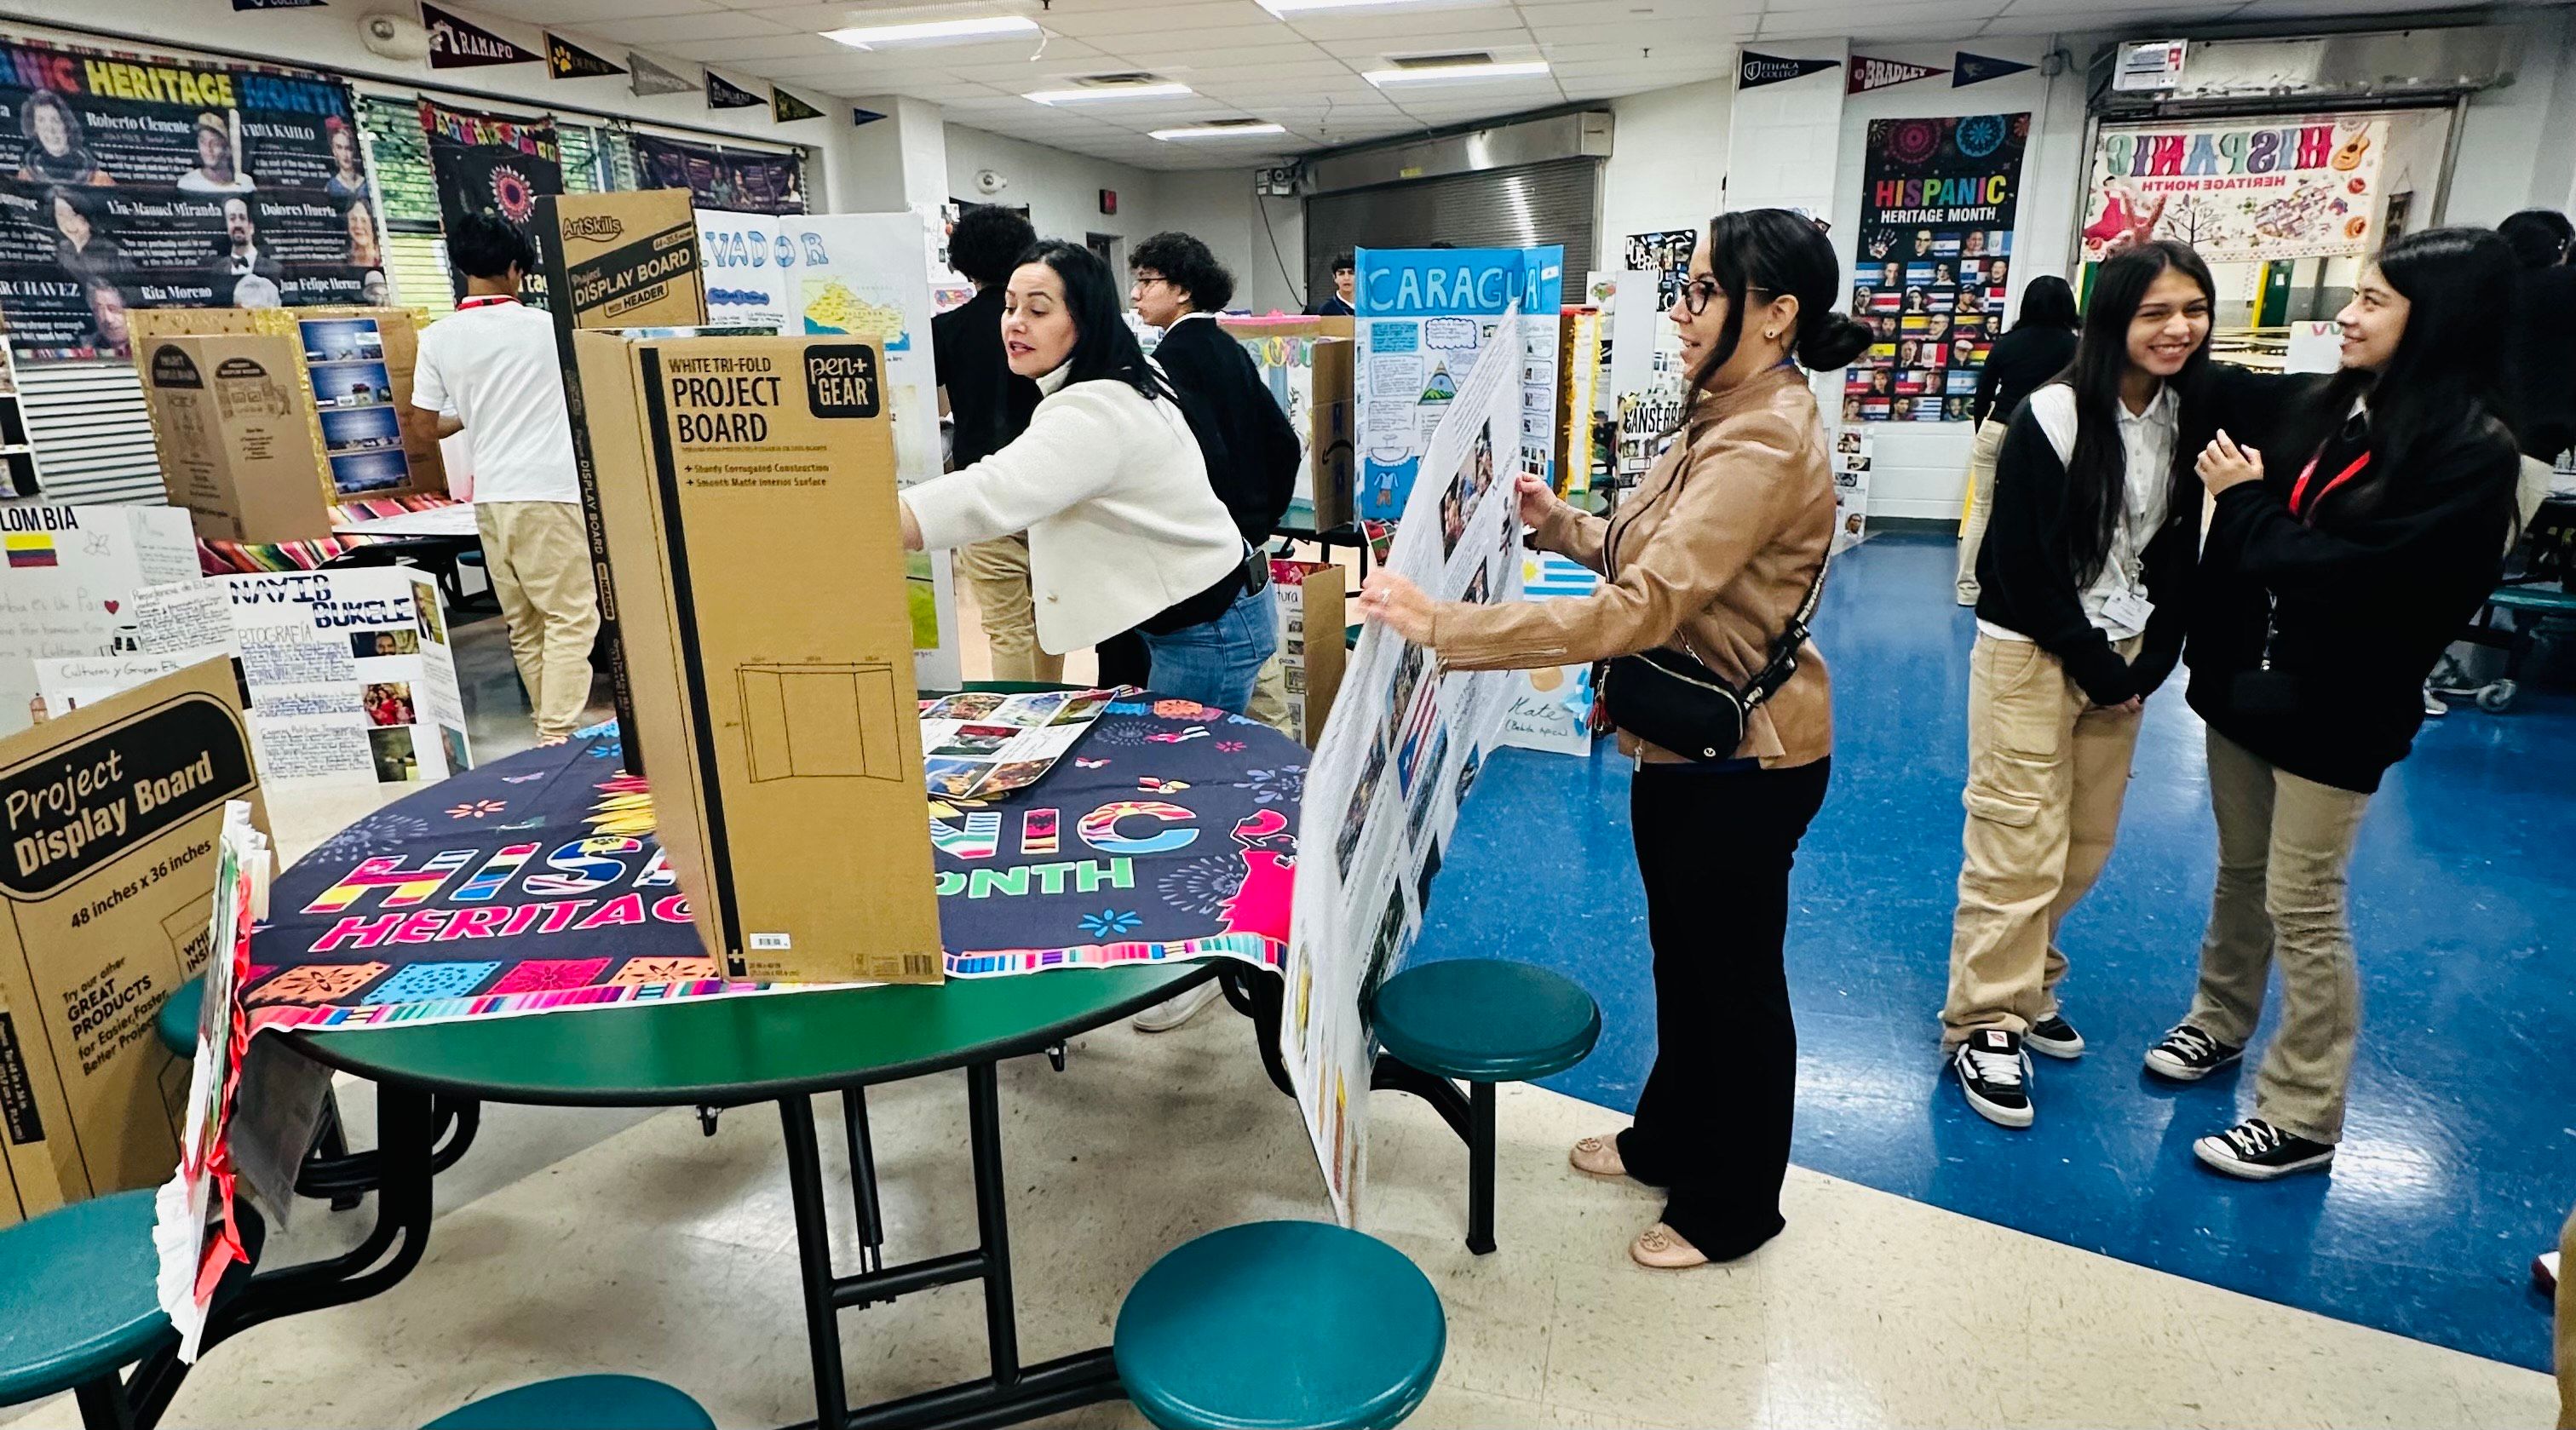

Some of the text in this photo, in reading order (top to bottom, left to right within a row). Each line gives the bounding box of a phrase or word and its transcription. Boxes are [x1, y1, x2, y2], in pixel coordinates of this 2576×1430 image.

[459, 31, 514, 59] RAMAPO
[1761, 70, 1799, 78] COLLEGE
[1762, 62, 1799, 72] ITHACA
[1863, 60, 1927, 89] BRADLEY
[85, 59, 237, 107] HERITAGE
[85, 112, 190, 134] Roberto Clemente
[273, 123, 314, 141] KAHLO
[1875, 175, 2007, 207] HISPANIC
[107, 200, 221, 217] Lin-Manuel Miranda
[260, 203, 337, 218] Dolores Huerta
[1880, 206, 1997, 224] HERITAGE MONTH
[562, 215, 623, 237] ArtSkills
[699, 231, 829, 267] VADOR
[13, 281, 81, 297] CHAVEZ
[279, 280, 298, 294] Juan
[298, 277, 330, 294] Felipe
[574, 248, 691, 307] DISPLAY BOARD
[141, 285, 212, 300] Rita Moreno
[623, 284, 664, 309] HEADER
[668, 357, 771, 373] WHITE TRI-FOLD
[672, 376, 781, 407] PROJECT
[678, 413, 768, 443] BOARD
[725, 463, 773, 474] Corrugated
[774, 462, 829, 474] Construction
[732, 478, 757, 486] Matte
[794, 477, 826, 486] Surface
[579, 460, 596, 511] DISPLAY
[589, 513, 604, 555] BOARD
[230, 574, 331, 605] NAYIB
[312, 598, 416, 629] BUKELE
[238, 621, 313, 644] BIOGRAFÍA
[5, 749, 124, 831] Project
[13, 797, 127, 878] Display
[133, 749, 214, 815] Board
[72, 839, 212, 929] 48 inches x 36 inches
[62, 956, 127, 1005] Try our other
[67, 978, 116, 1022] GREAT
[72, 974, 152, 1042] PRODUCTS
[78, 1042, 95, 1061] for
[83, 1045, 116, 1077] Better
